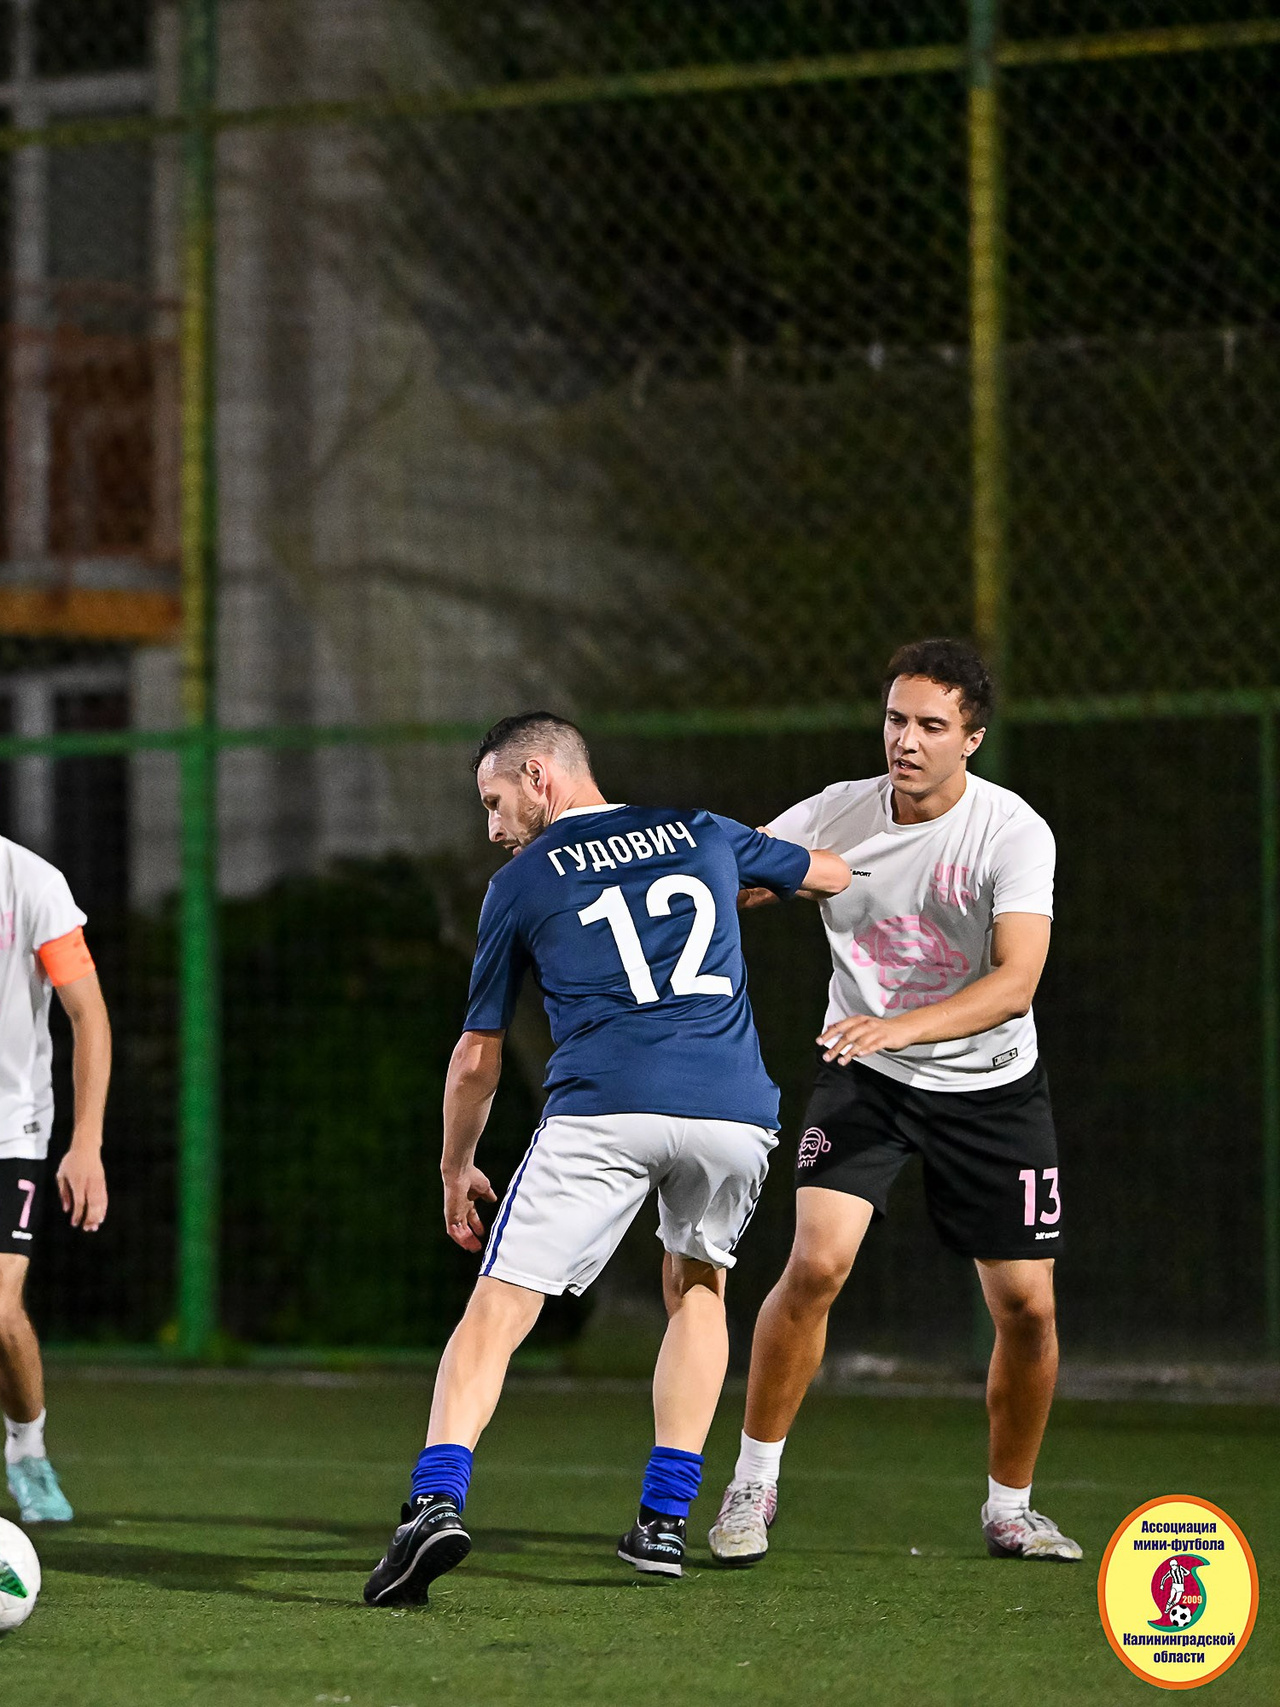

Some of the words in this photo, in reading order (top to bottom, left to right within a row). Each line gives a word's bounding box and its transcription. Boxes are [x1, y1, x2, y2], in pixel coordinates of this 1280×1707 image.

[547, 821, 697, 877] ГУДОВИЧ
[577, 874, 733, 1005] 12
[18, 1179, 35, 1229] 7
[1019, 1167, 1061, 1226] 13
